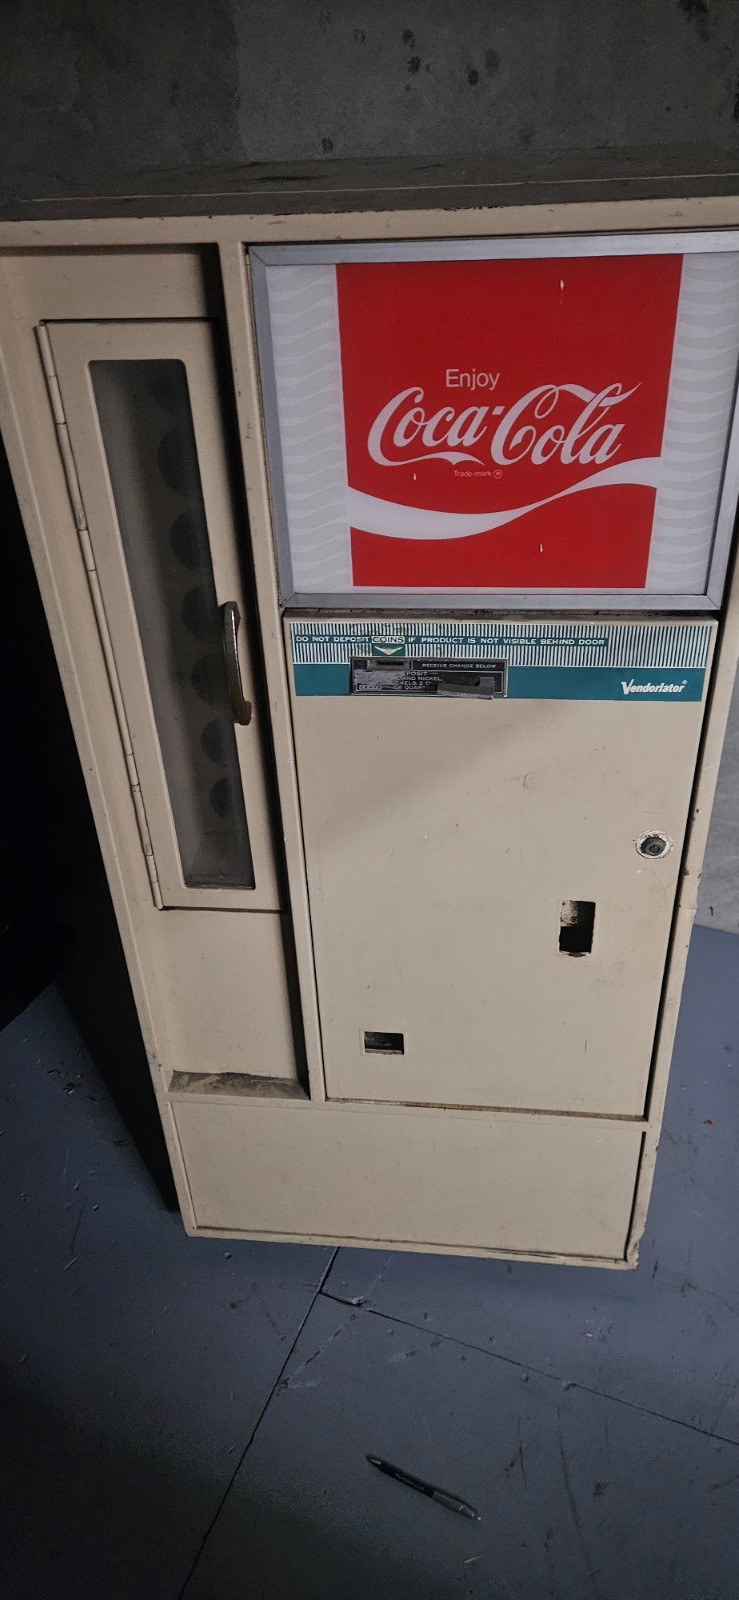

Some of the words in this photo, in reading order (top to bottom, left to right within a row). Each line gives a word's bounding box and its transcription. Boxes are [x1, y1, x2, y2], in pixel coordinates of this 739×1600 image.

[445, 368, 500, 390] Enjoy
[367, 382, 642, 467] Coca-Cola
[372, 636, 405, 644] COINS
[620, 678, 686, 695] Vendorlator
